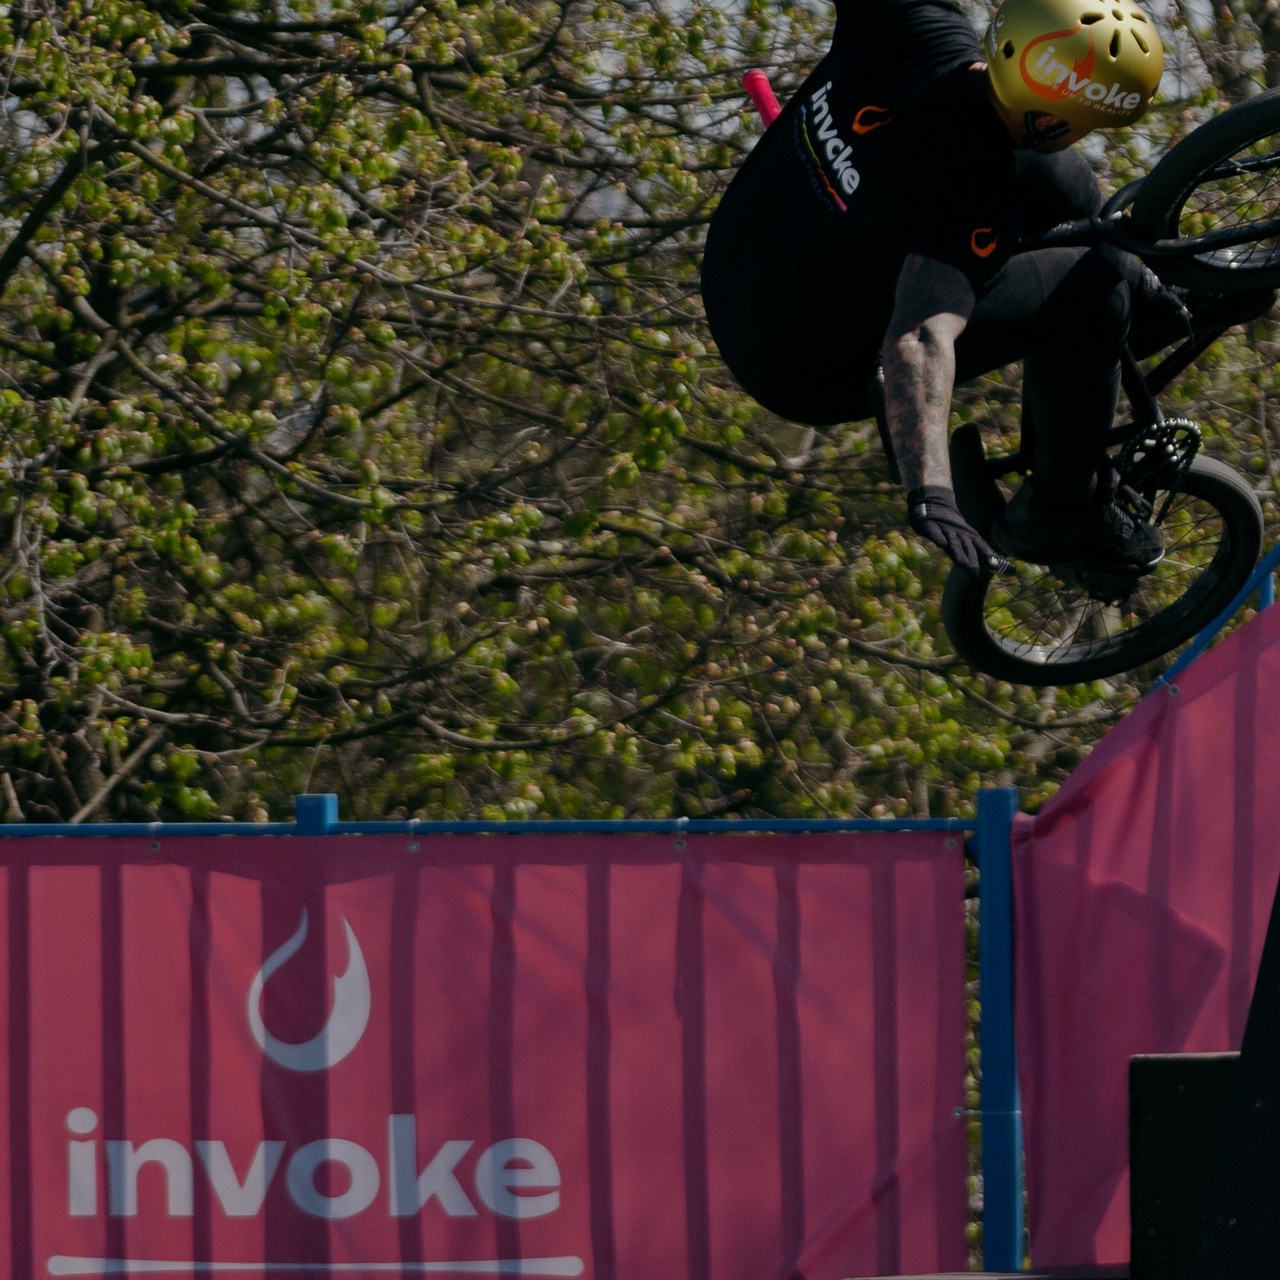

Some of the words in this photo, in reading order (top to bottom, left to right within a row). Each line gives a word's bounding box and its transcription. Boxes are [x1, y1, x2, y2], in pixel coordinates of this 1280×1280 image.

[1036, 45, 1142, 110] invoke
[810, 80, 861, 195] invoke
[66, 1106, 562, 1219] invoke
